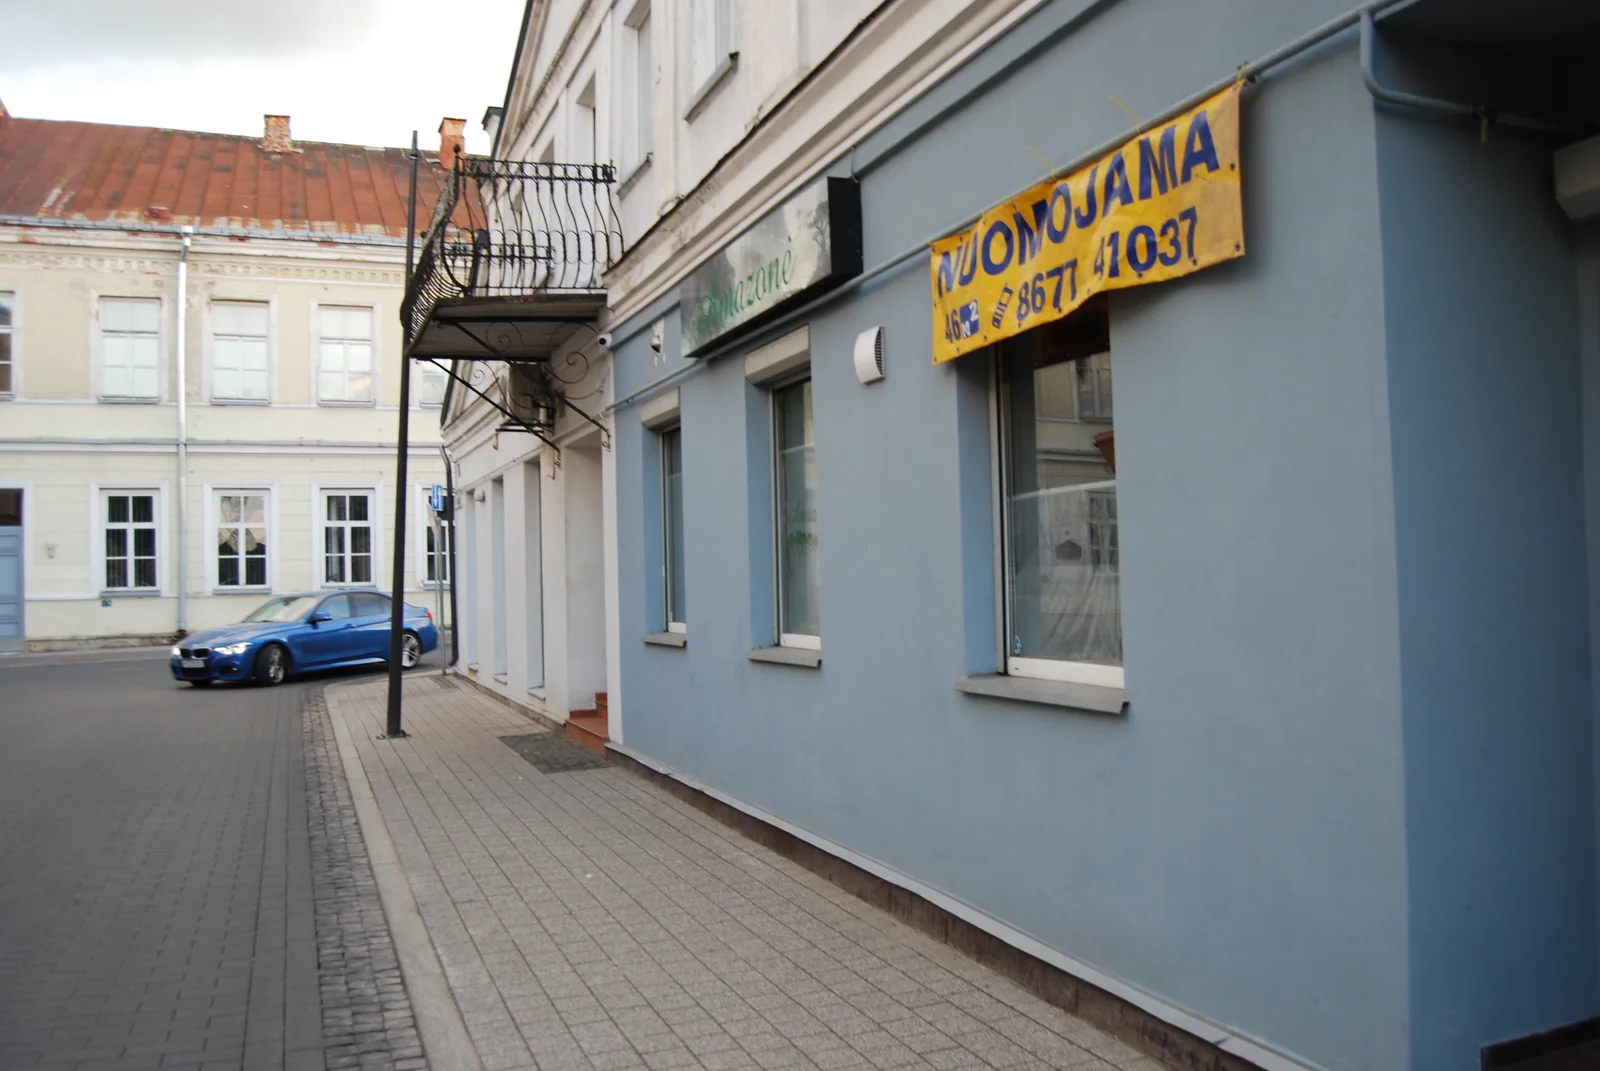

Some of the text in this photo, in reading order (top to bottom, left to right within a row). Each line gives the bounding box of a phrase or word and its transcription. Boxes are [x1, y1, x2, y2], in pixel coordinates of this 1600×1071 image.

[937, 109, 1220, 298] NUOMOJAMA
[1016, 257, 1078, 321] 8677
[1094, 206, 1198, 283] 41037
